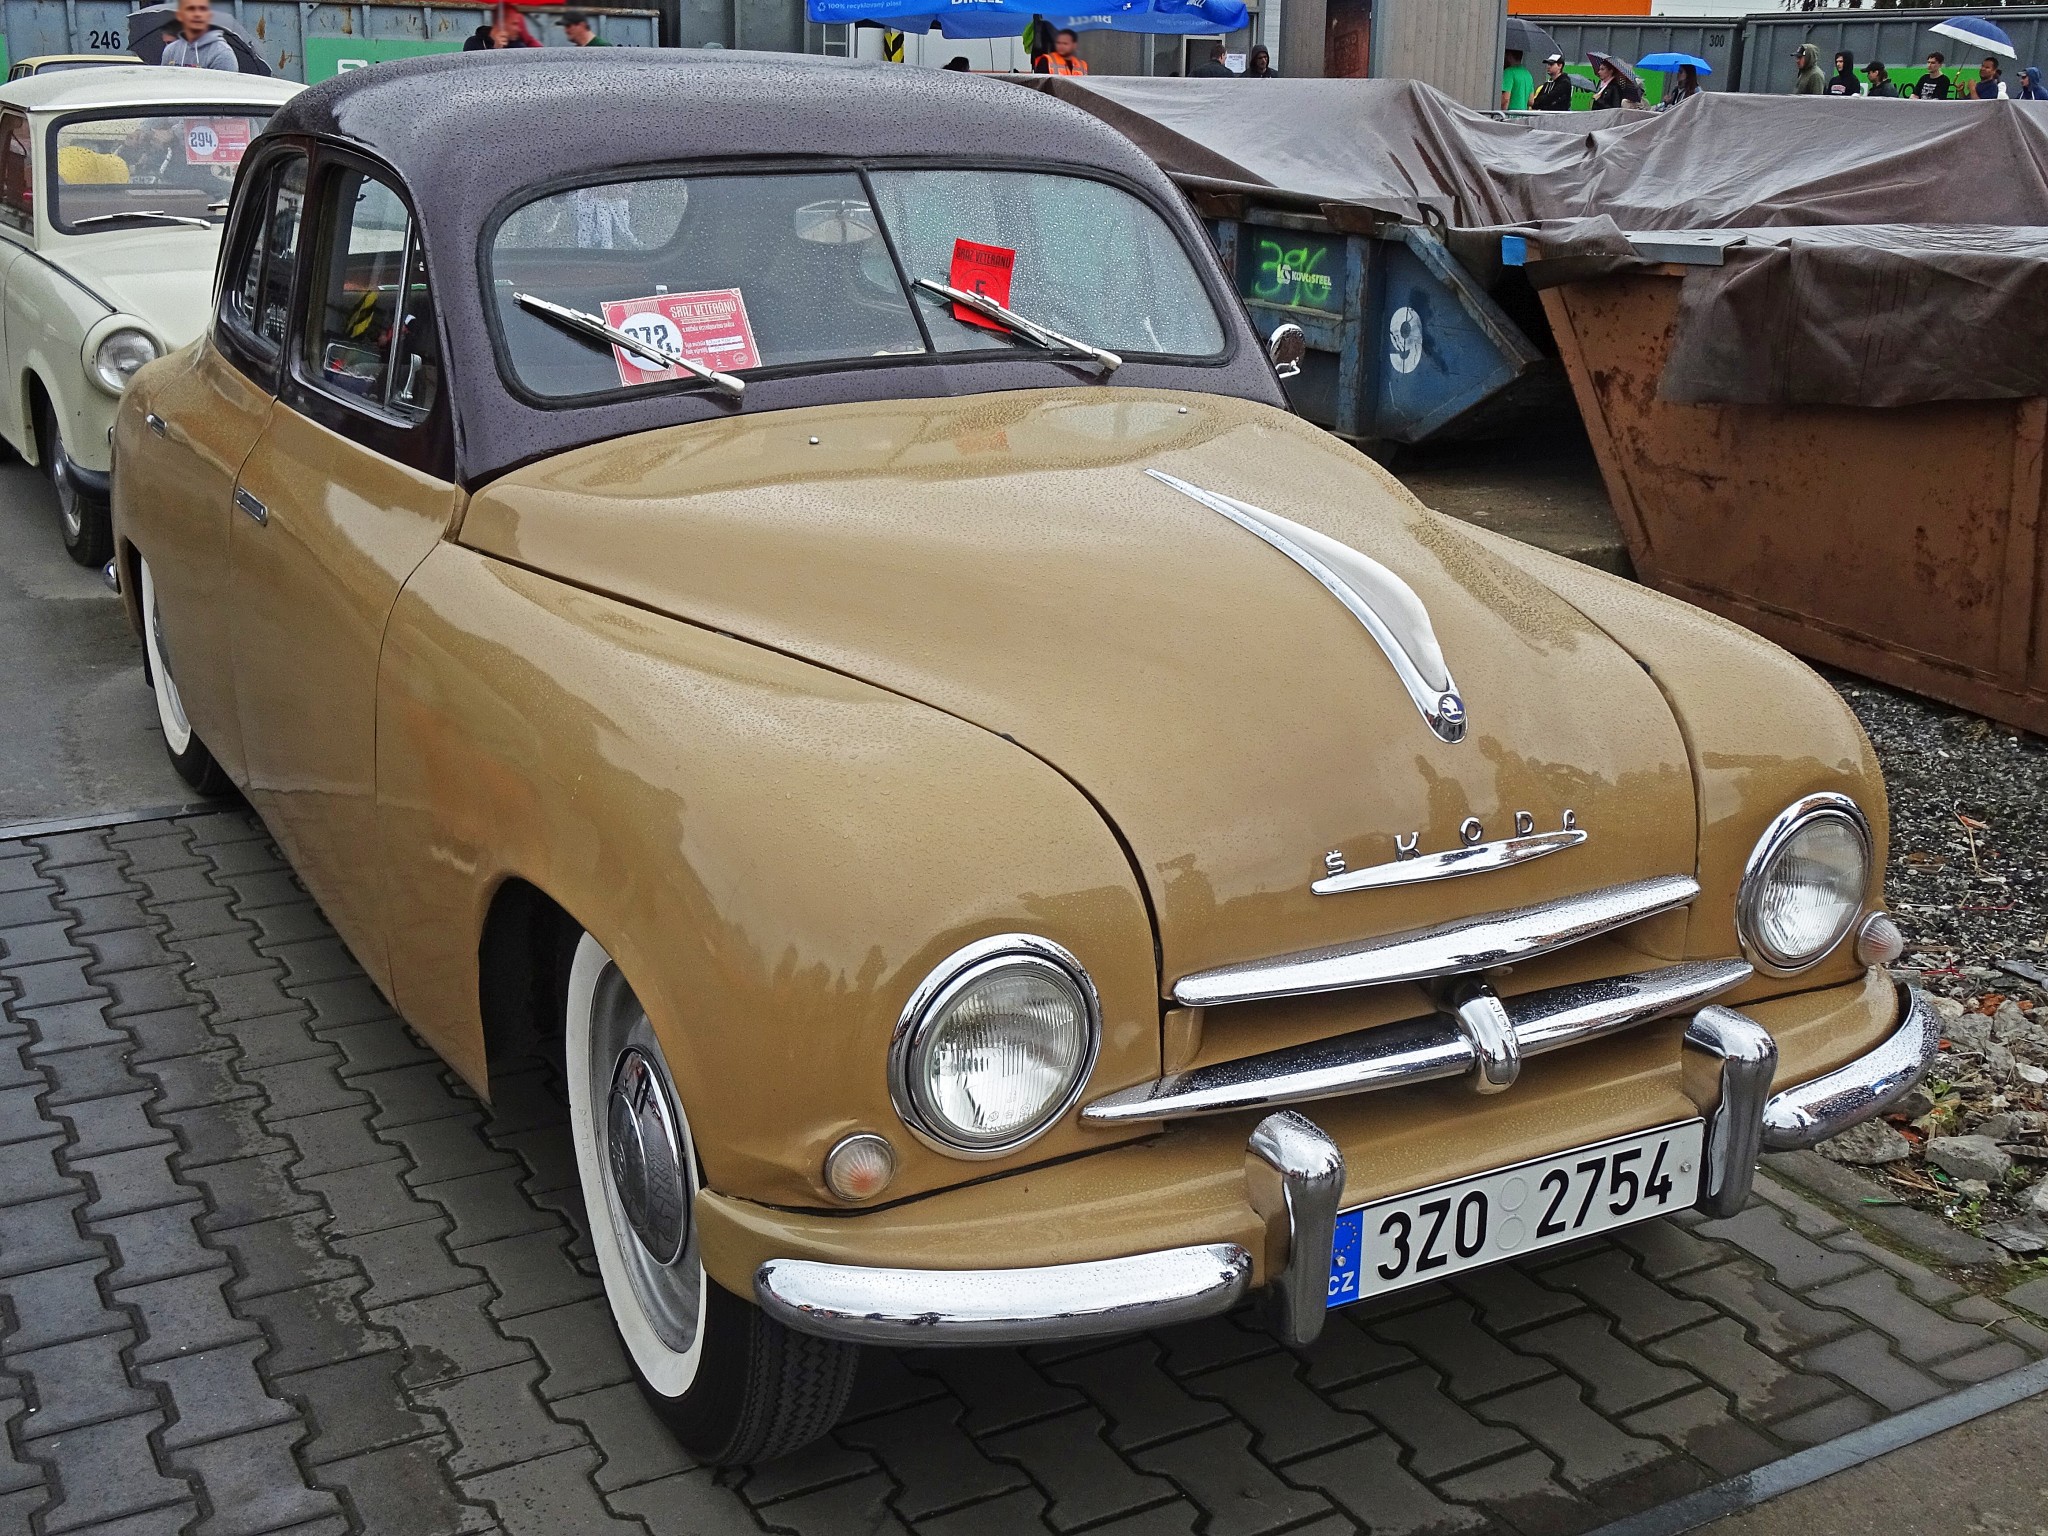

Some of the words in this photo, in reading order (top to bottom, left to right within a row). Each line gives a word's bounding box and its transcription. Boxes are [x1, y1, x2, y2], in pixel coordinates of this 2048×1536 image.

[89, 30, 121, 50] 246
[1709, 34, 1725, 48] 300
[1389, 306, 1423, 374] 9
[1535, 1140, 1674, 1240] 2754
[1327, 1270, 1355, 1298] CZ
